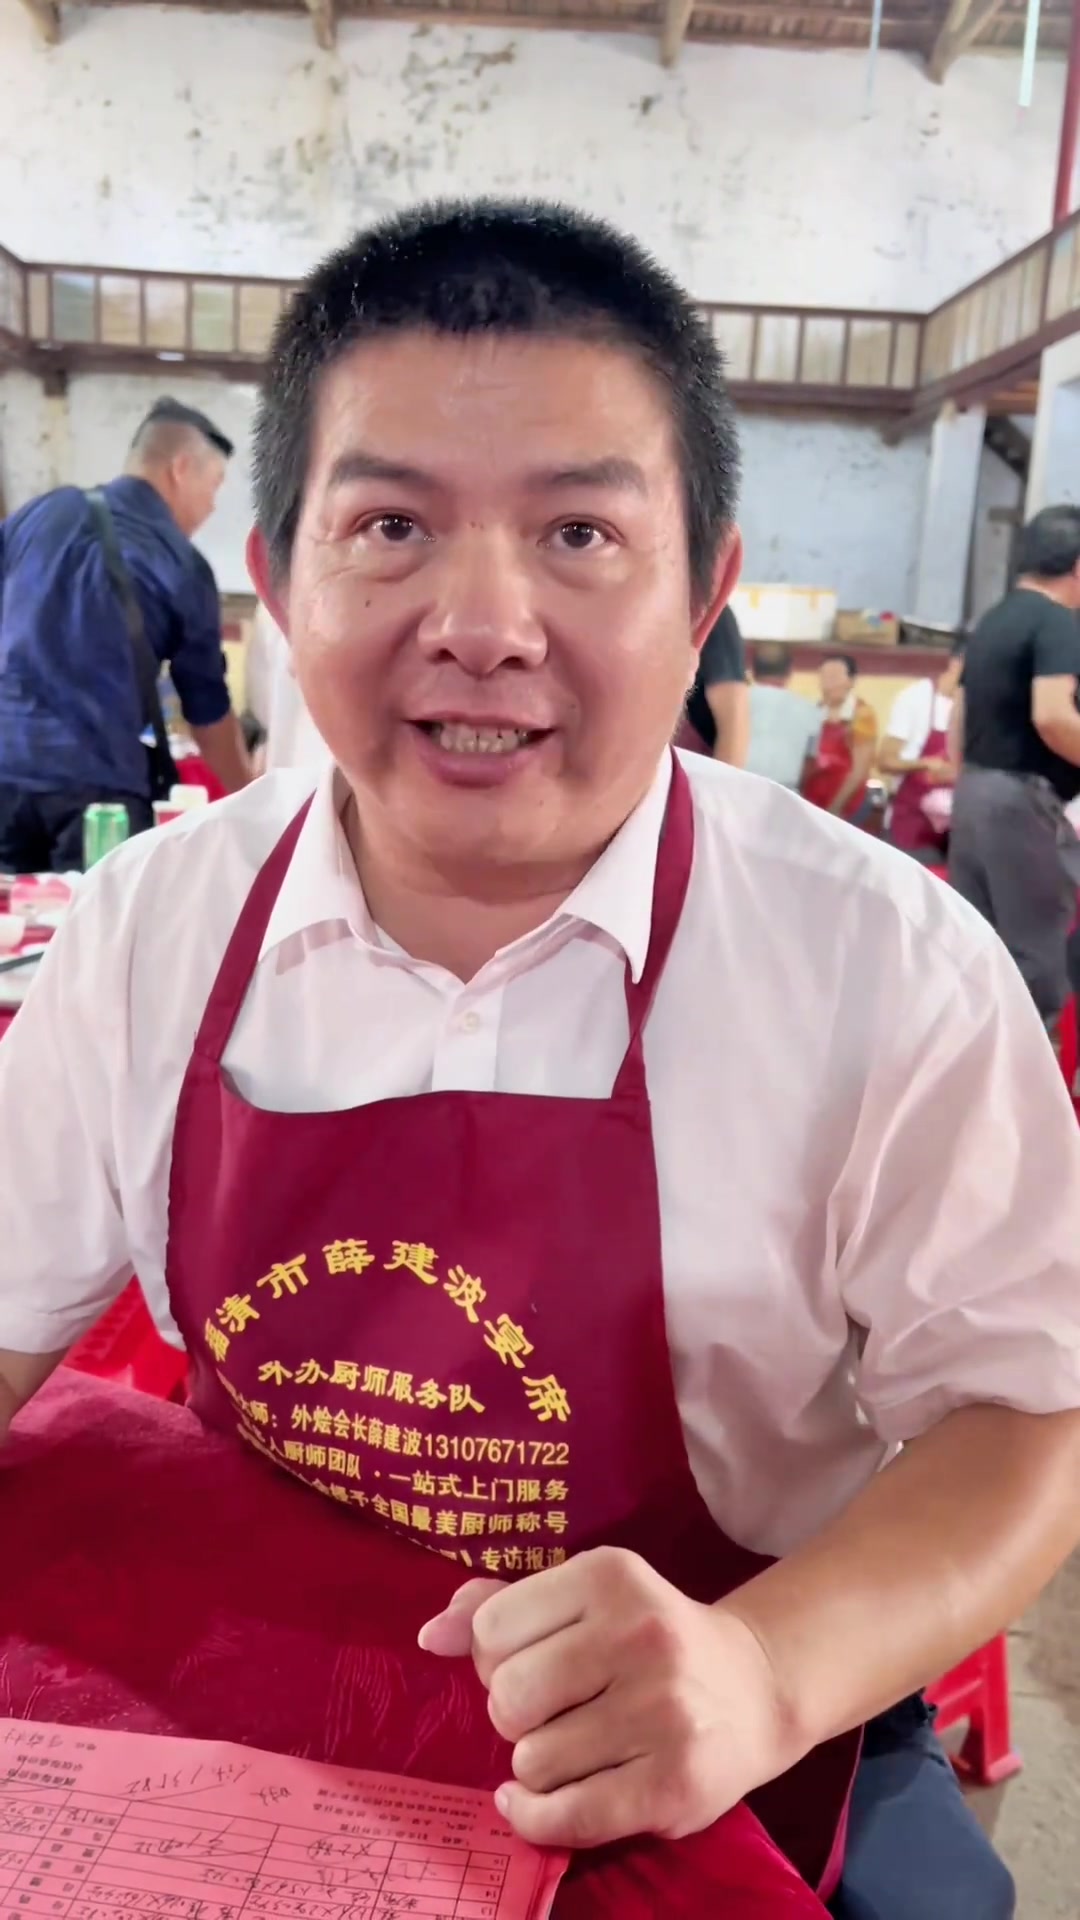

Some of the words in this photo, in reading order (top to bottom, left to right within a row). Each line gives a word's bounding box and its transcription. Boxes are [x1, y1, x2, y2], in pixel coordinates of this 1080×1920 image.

[258, 1358, 486, 1414] 外办厨师服务队
